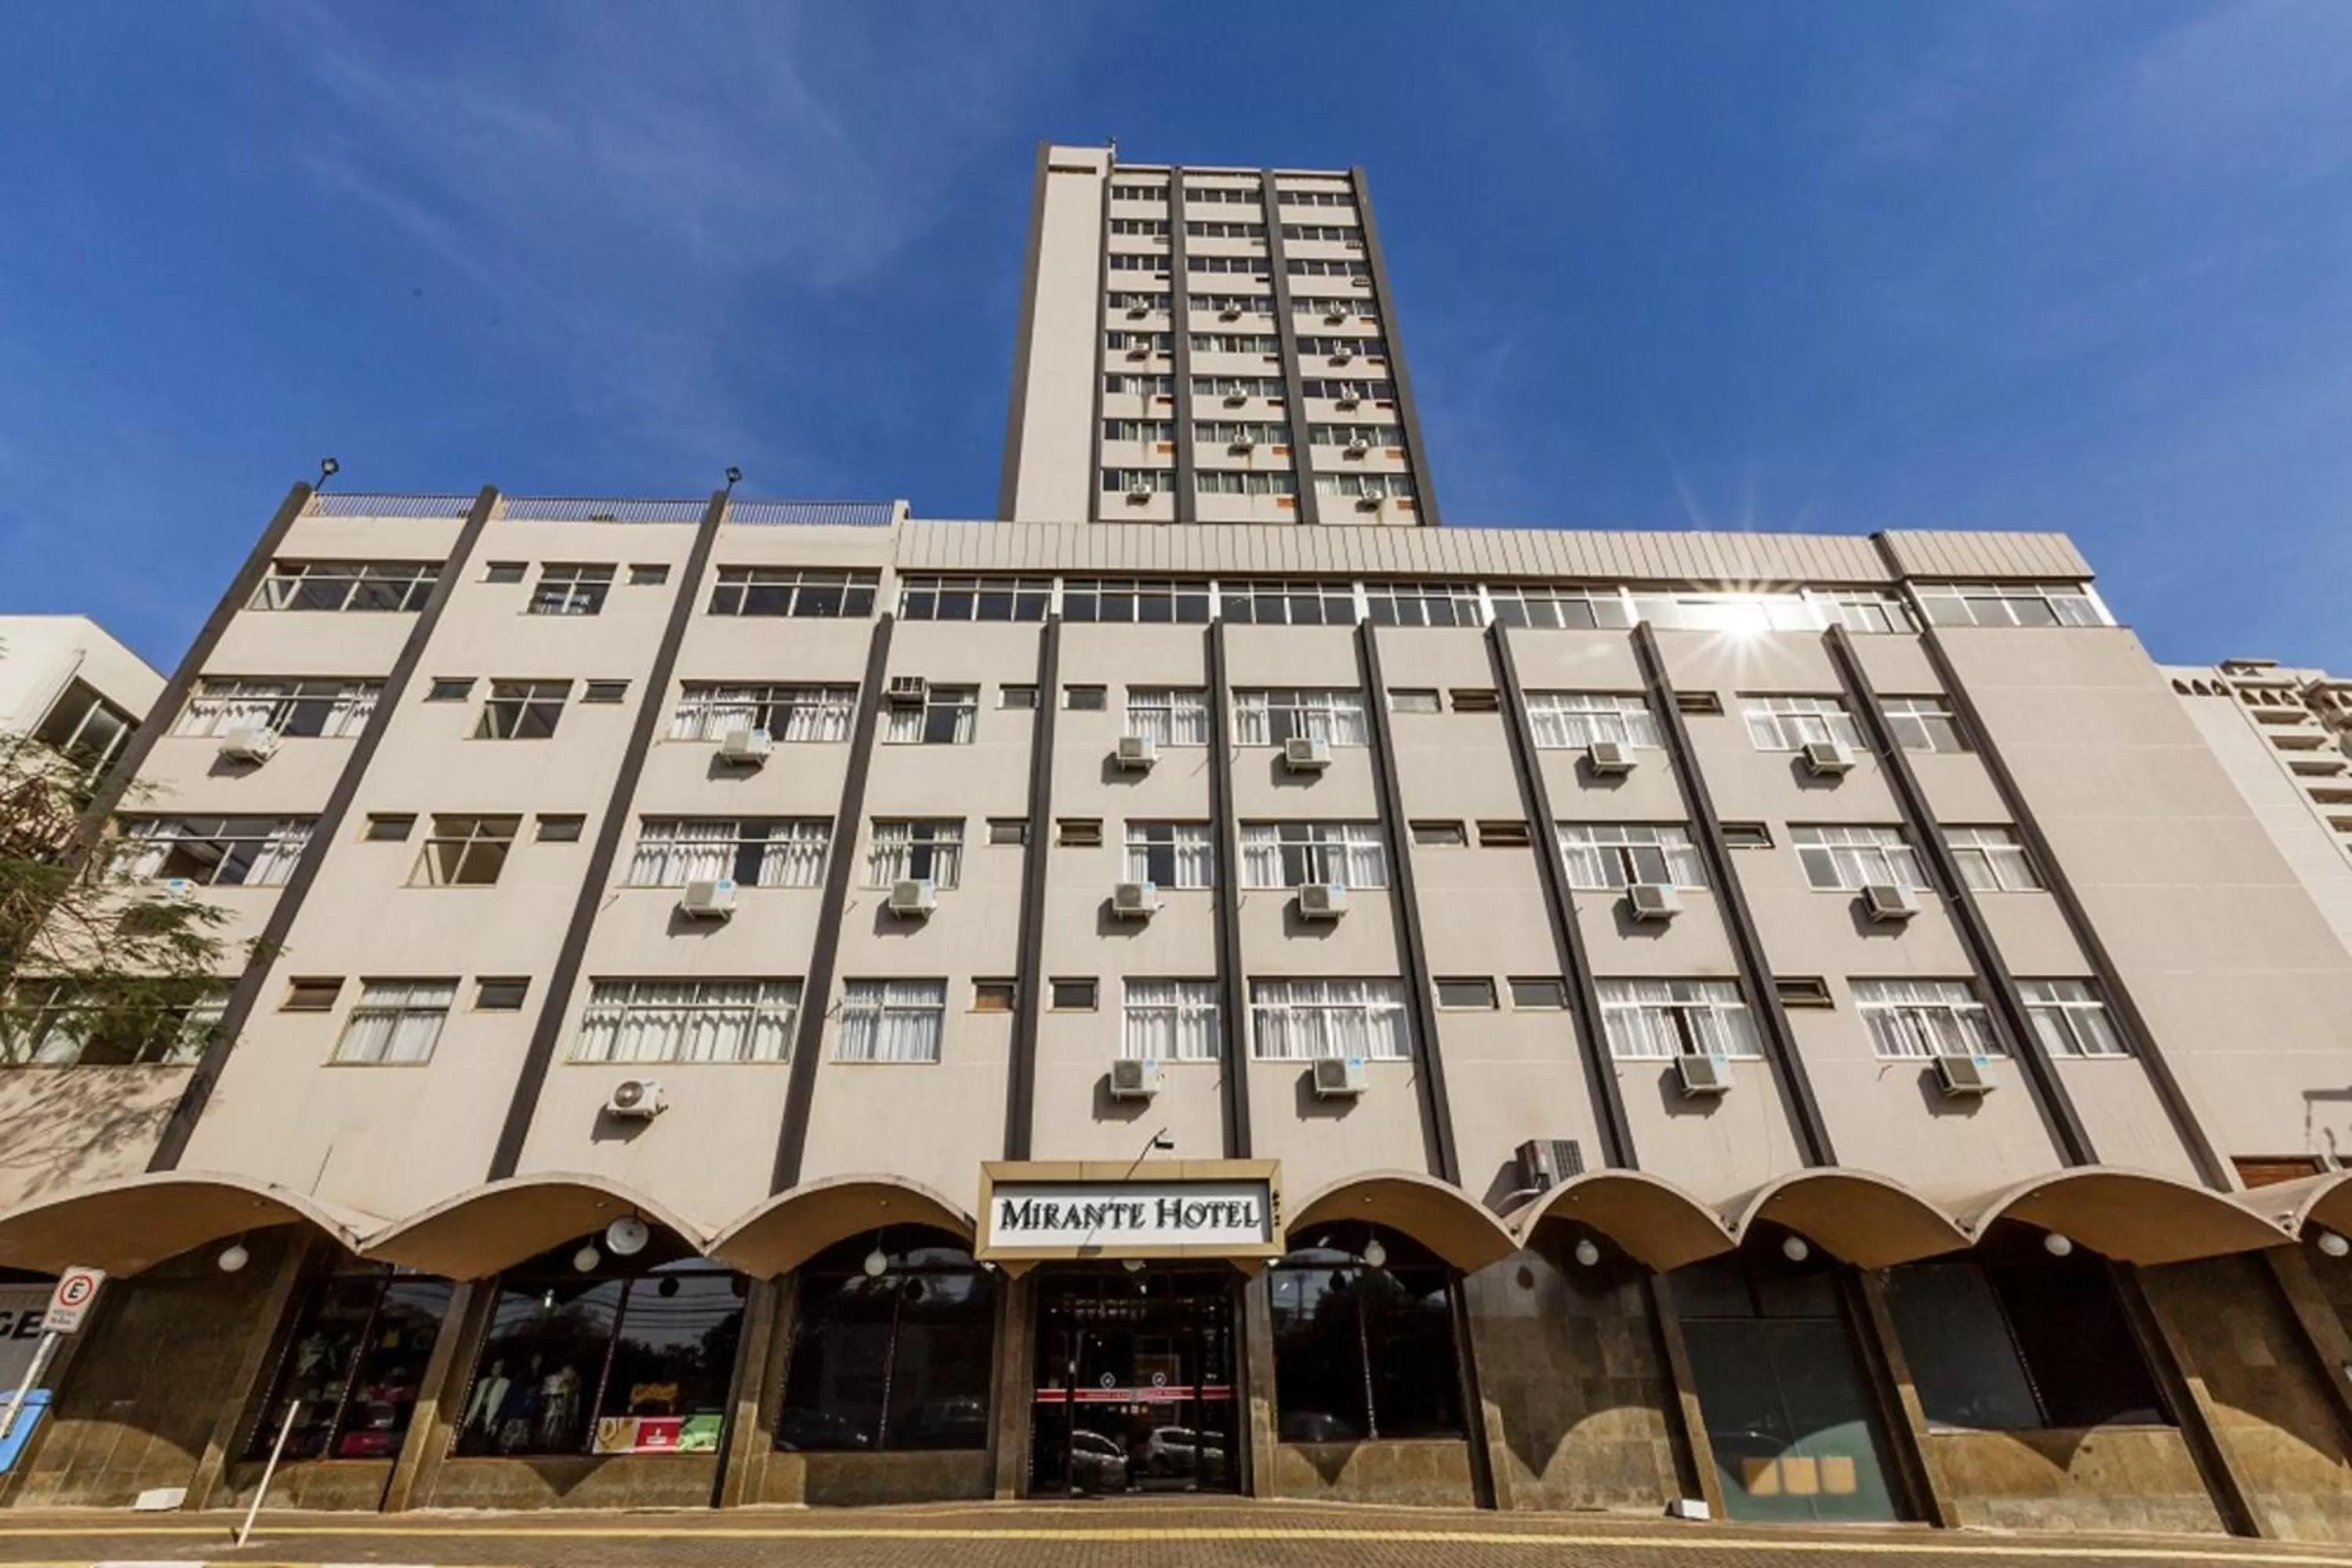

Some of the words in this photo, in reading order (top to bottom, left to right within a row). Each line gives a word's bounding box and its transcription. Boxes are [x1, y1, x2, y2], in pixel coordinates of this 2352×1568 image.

[1000, 1198, 1145, 1230] MIRANTE
[1155, 1197, 1261, 1229] HOTEL
[68, 1281, 85, 1298] E
